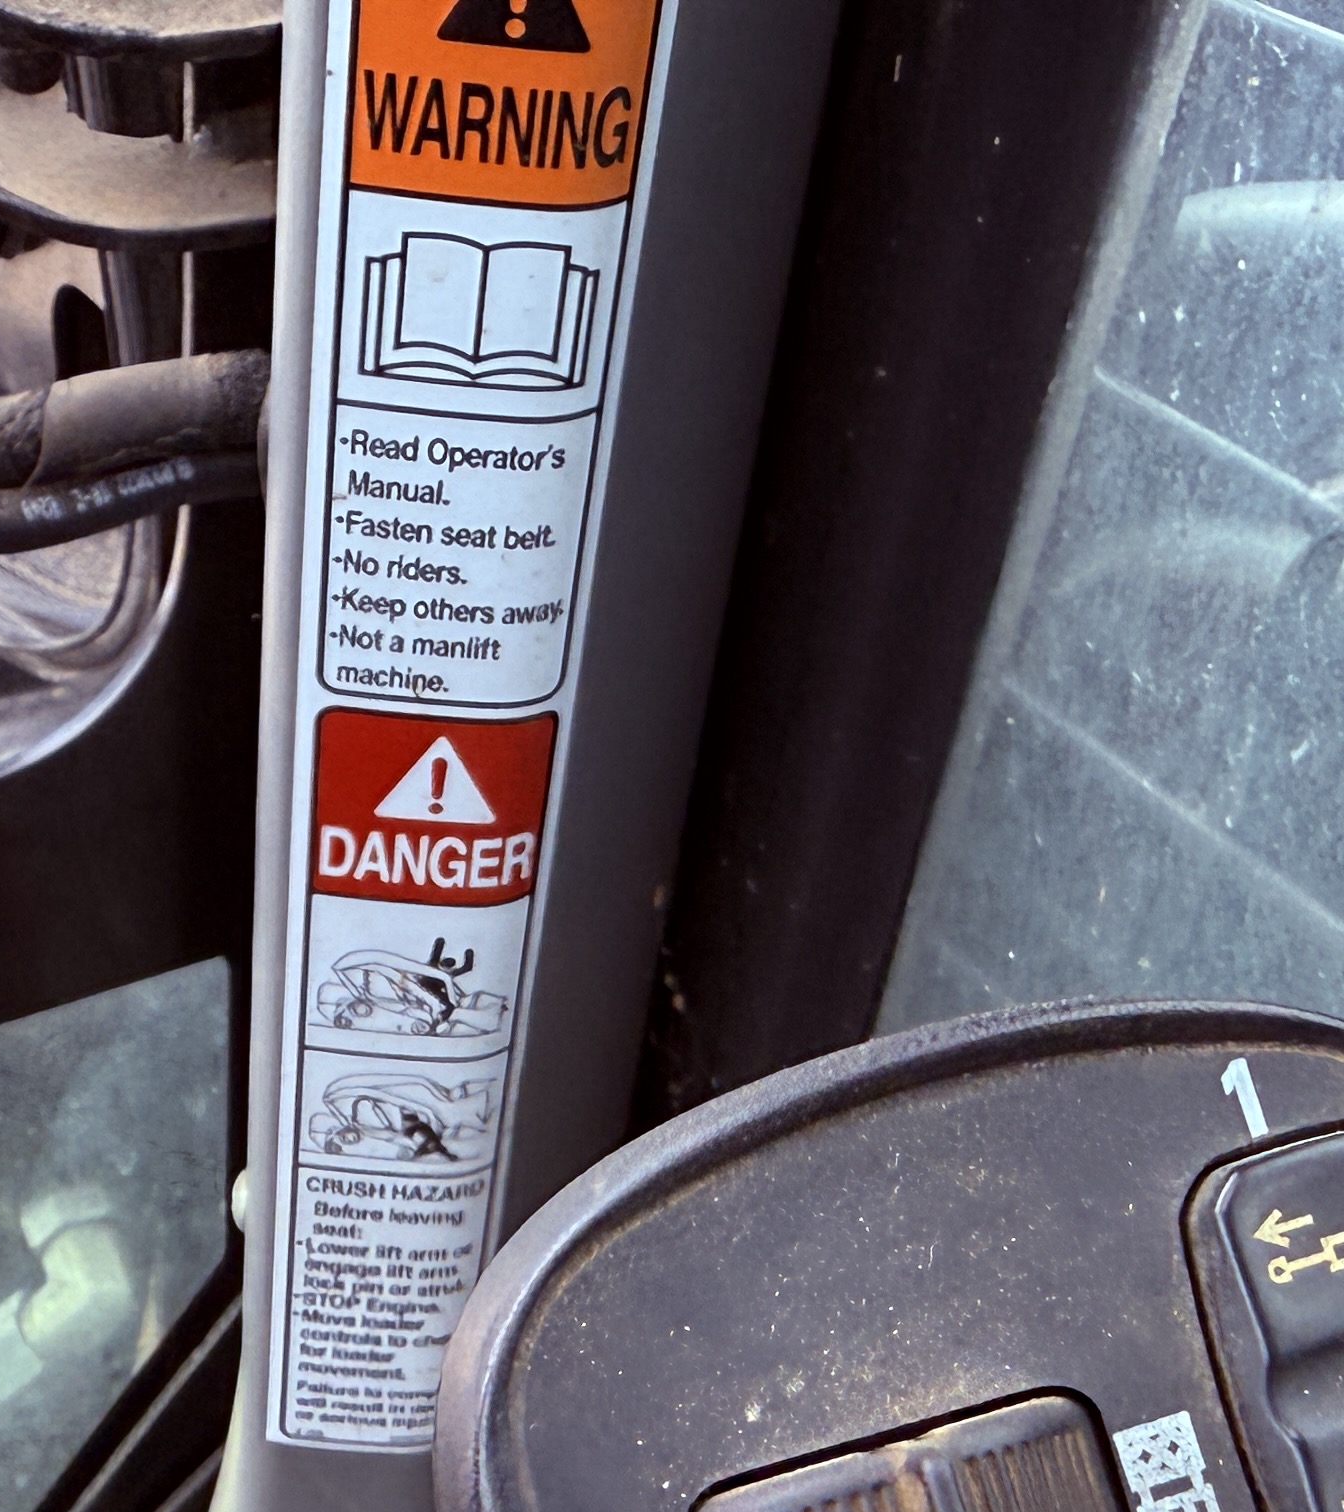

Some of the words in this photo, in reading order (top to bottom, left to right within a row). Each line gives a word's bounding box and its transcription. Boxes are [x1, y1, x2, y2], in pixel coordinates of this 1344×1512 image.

[363, 69, 632, 170] WARNING
[427, 437, 566, 472] Operator's
[347, 469, 451, 505] Manual.
[440, 525, 497, 549] seat
[386, 554, 468, 585] riders.
[413, 598, 495, 624] others
[389, 633, 405, 653] a
[411, 636, 502, 661] manlift
[336, 665, 449, 693] machine.
[318, 825, 537, 889] DANGER
[1220, 1057, 1269, 1138] 1
[306, 1175, 386, 1200] CRUSH
[391, 1178, 486, 1202] HAZARD
[313, 1201, 384, 1223] Before
[388, 1207, 465, 1227] leaving
